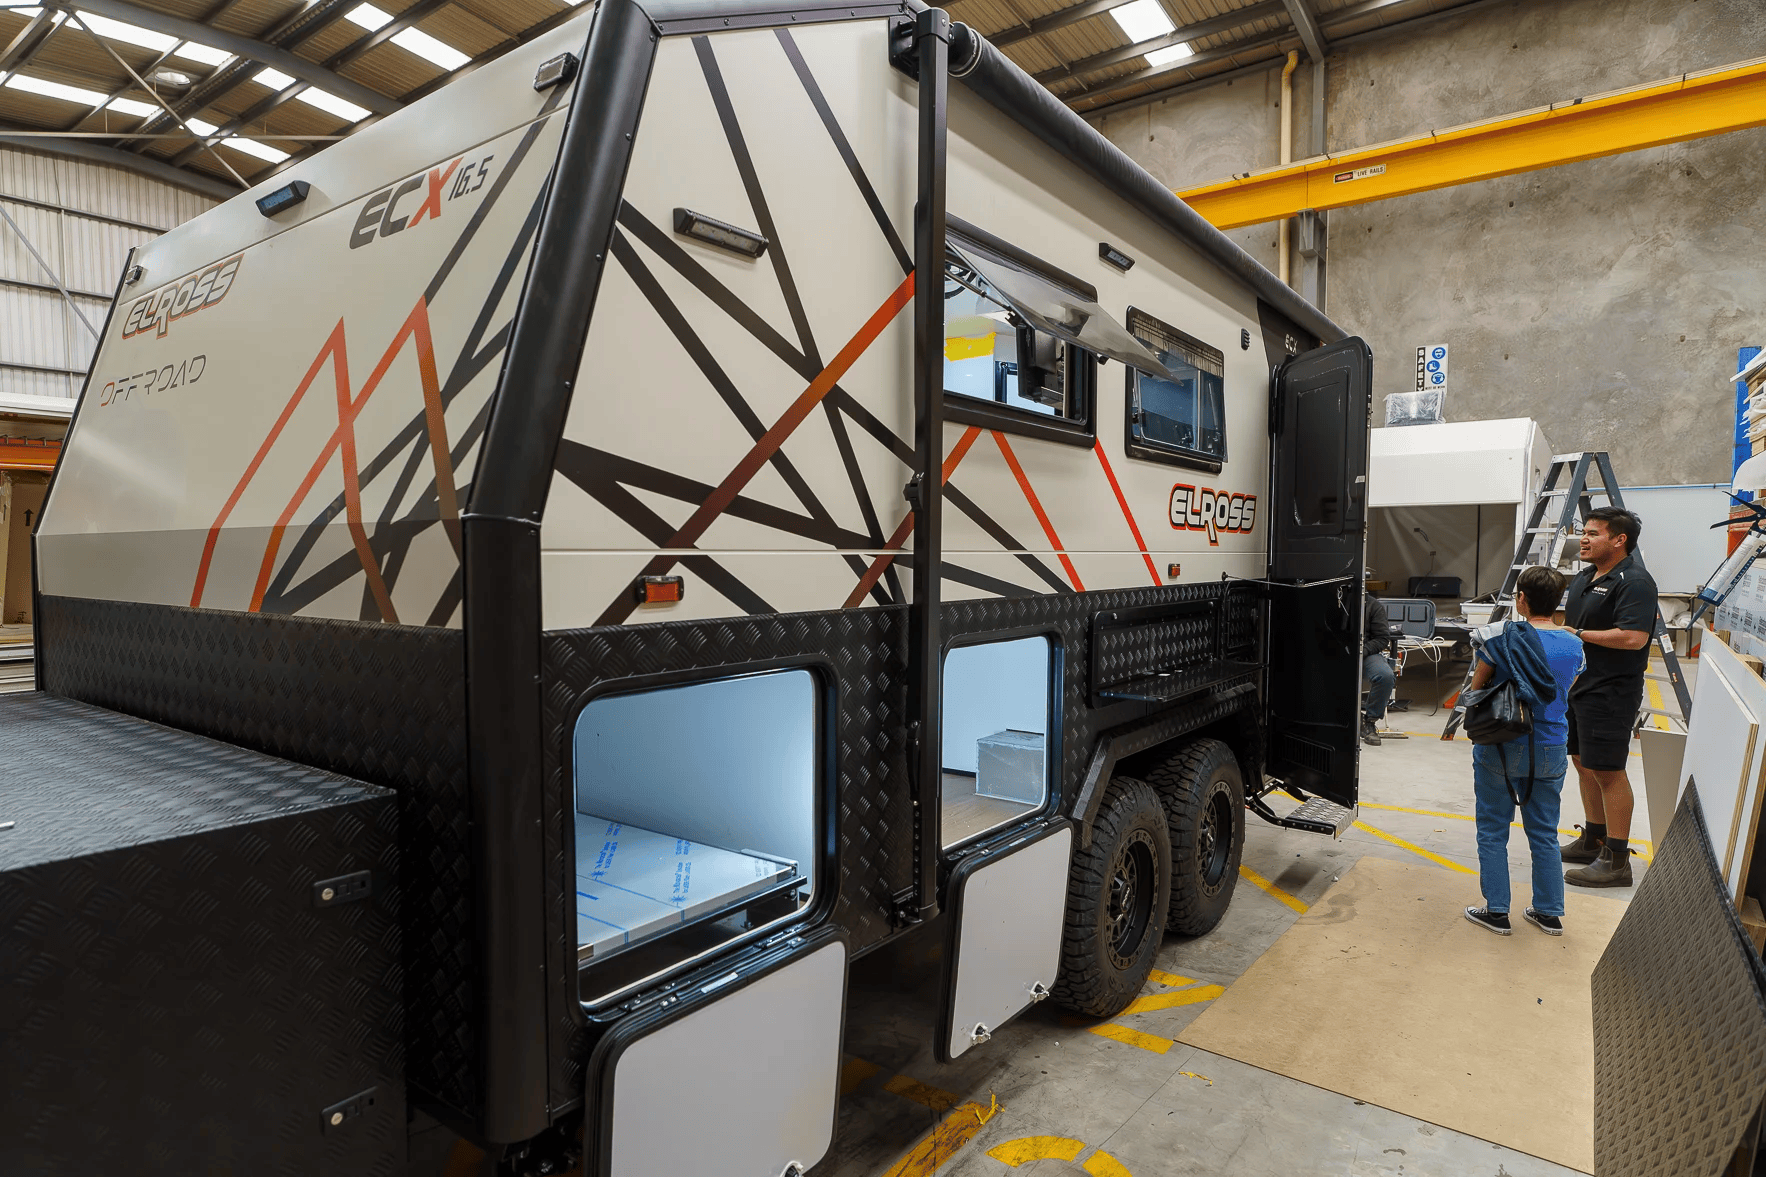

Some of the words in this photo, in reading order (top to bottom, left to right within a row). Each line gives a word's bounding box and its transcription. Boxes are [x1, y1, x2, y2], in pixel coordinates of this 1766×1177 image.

[349, 156, 465, 250] ECX
[448, 154, 495, 202] 16.5
[1357, 169, 1368, 177] LIVE
[1369, 166, 1384, 174] RAILS
[122, 253, 245, 340] ELROSS
[1168, 482, 1258, 547] ELROSS
